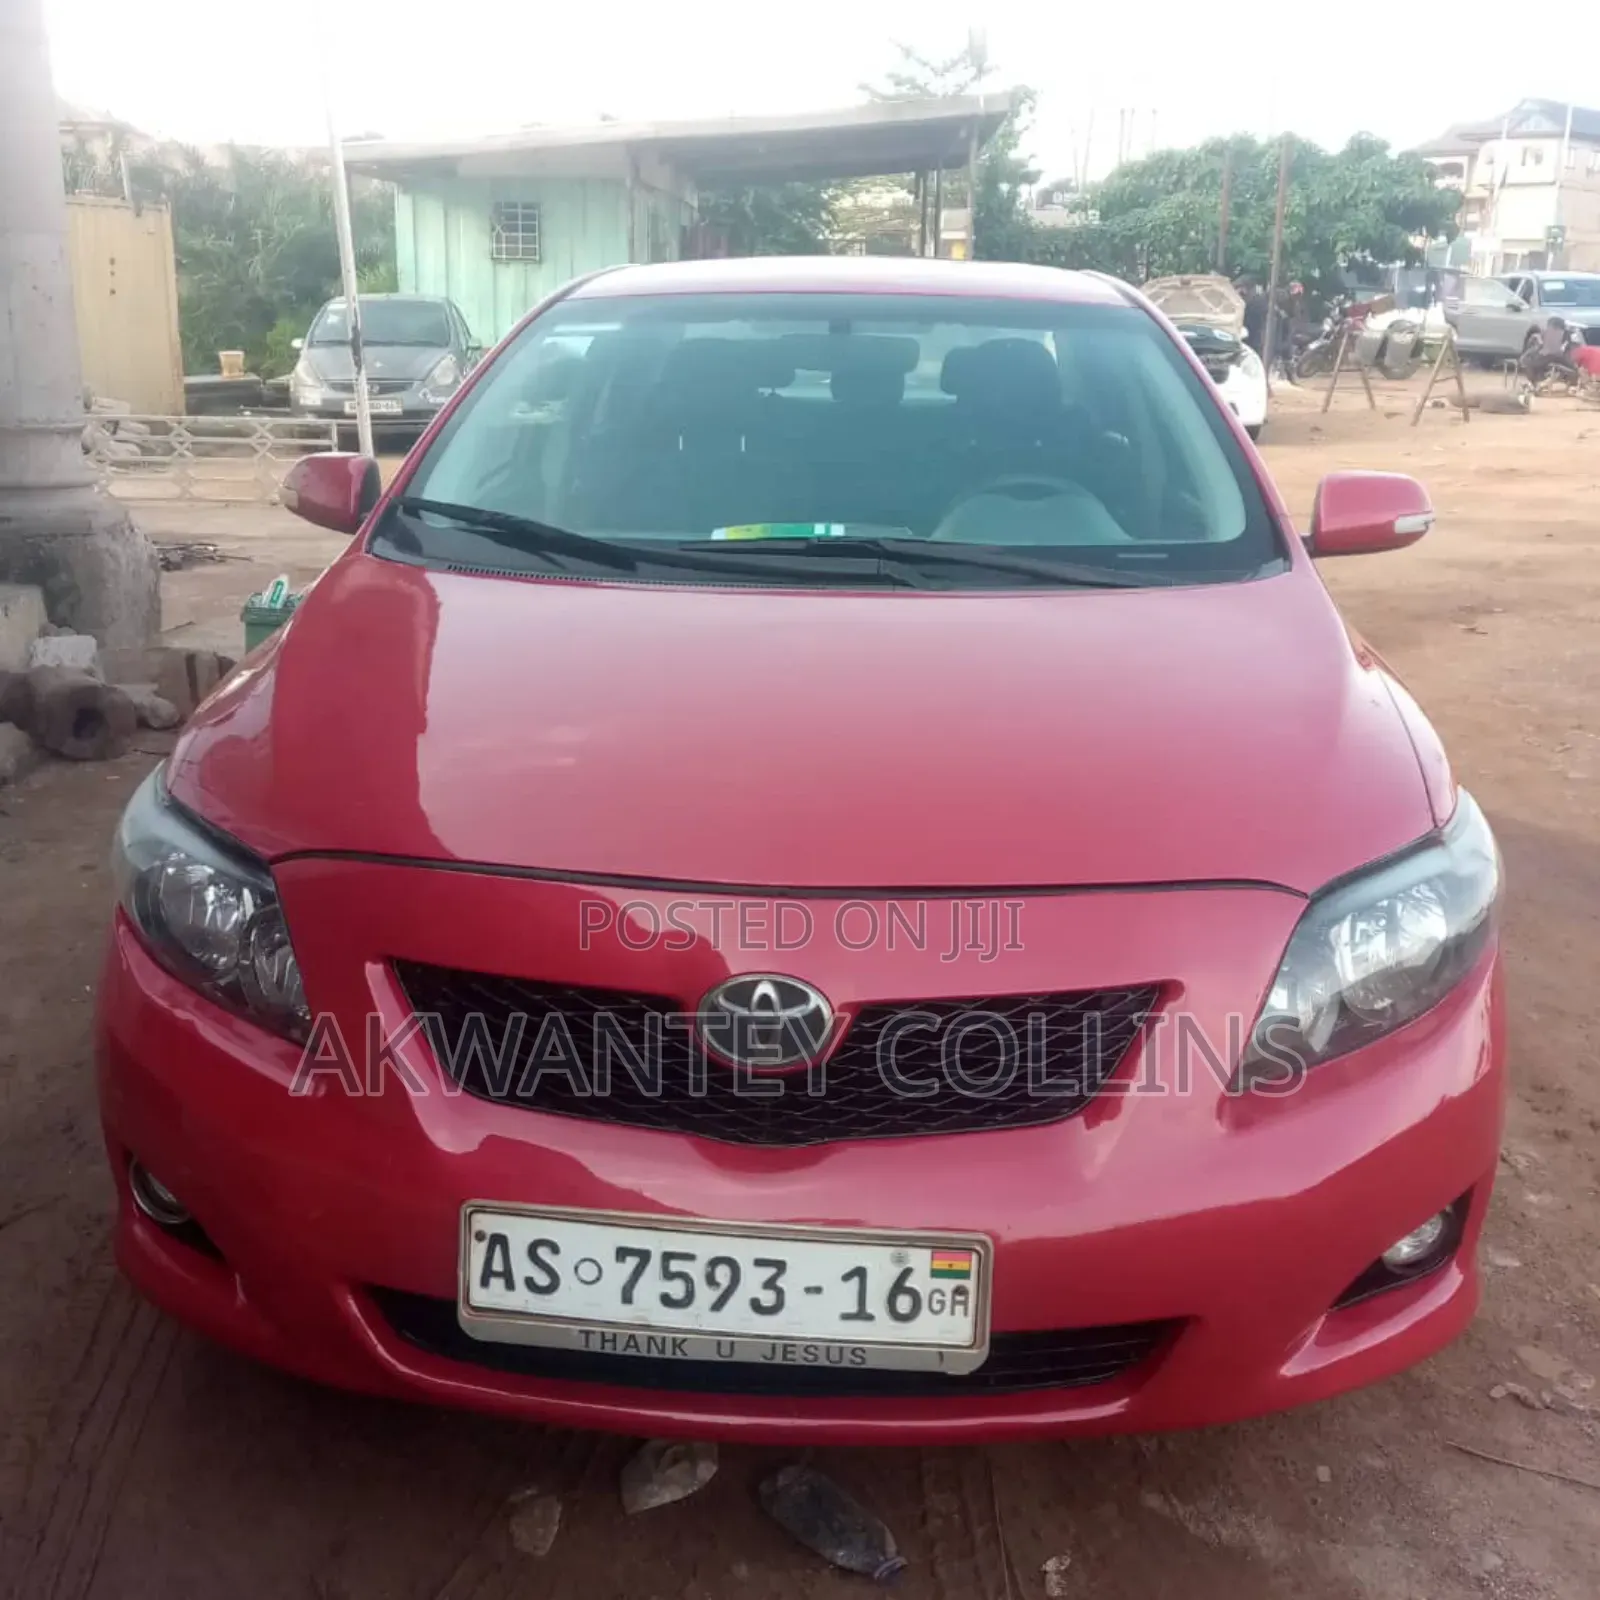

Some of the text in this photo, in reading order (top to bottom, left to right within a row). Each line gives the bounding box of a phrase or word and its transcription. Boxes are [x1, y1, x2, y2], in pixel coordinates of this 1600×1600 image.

[480, 1233, 561, 1295] AS
[578, 1329, 867, 1366] THANK U JESUS
